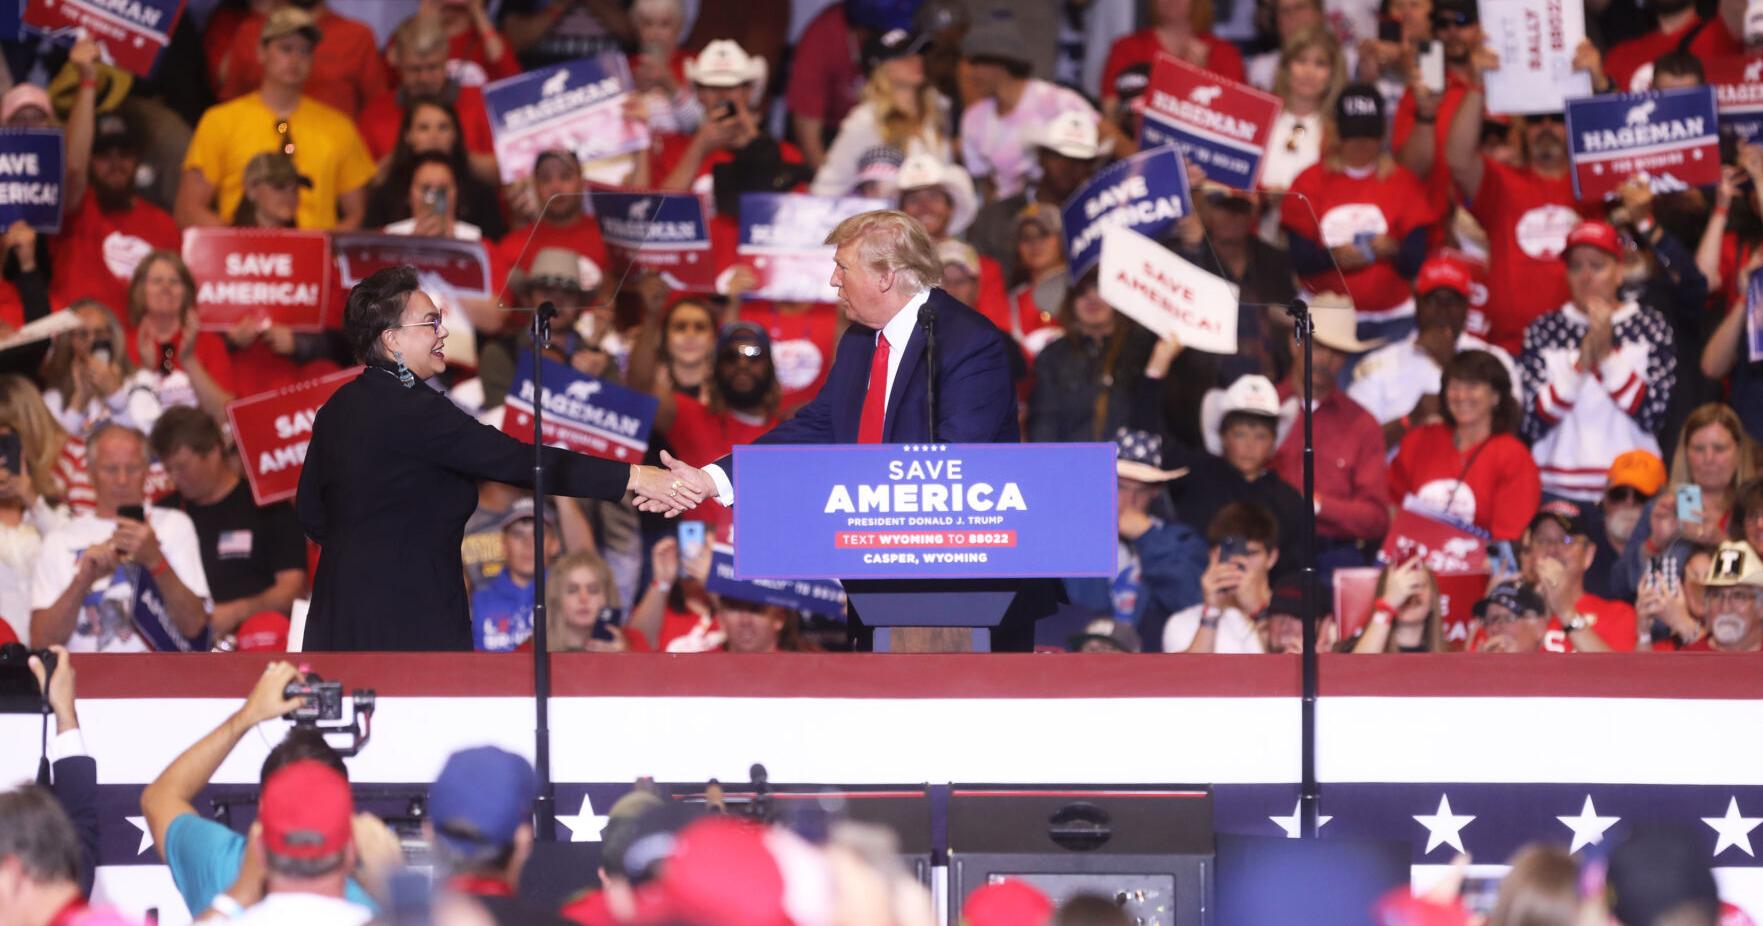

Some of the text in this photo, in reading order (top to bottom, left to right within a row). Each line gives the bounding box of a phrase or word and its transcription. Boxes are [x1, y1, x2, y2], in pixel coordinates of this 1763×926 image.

[1583, 115, 1704, 151] HAGEMAN
[0, 153, 39, 176] AVE
[0, 181, 59, 206] ERICA!
[1084, 175, 1150, 220] SAVE
[225, 252, 293, 277] SAVE
[1142, 259, 1195, 301] SAVE
[198, 281, 318, 306] AMERICA!
[1115, 270, 1223, 333] AMERICA!
[888, 459, 963, 481] SAVE
[824, 482, 1028, 514] AMERICA
[847, 515, 1005, 527] PRESIDENT DONALD J. TRUMP
[842, 532, 1010, 545] TEXT WYOMING TO 88022
[863, 552, 989, 566] CASPER, WYOMING
